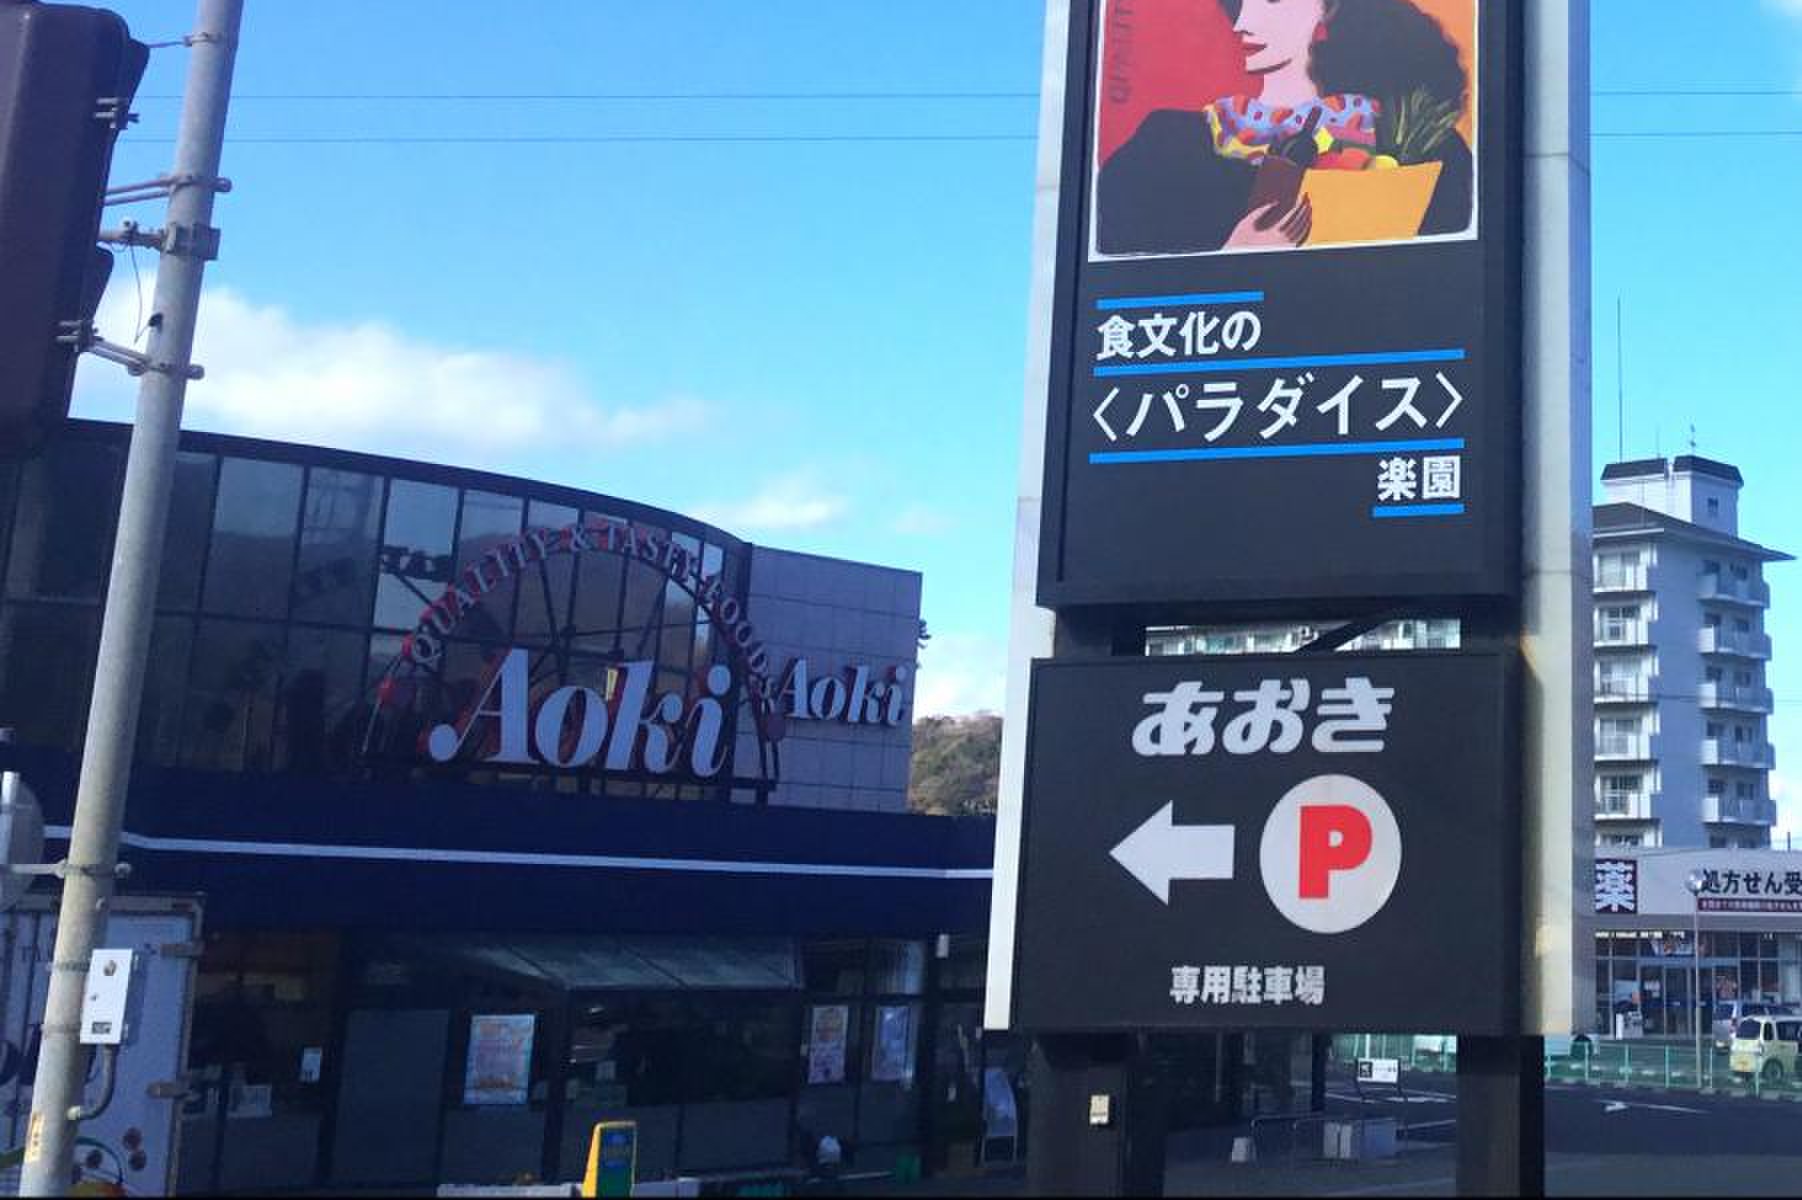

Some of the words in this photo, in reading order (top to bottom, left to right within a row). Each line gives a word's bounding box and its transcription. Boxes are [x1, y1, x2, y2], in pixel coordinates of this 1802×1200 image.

[1096, 311, 1262, 360] 食文化の
[1376, 455, 1461, 502] 楽園
[413, 532, 548, 672] QUALITY
[428, 648, 730, 777] Aoki
[778, 657, 908, 726] Aoki
[1132, 676, 1395, 757] あおき
[1298, 805, 1373, 900] P
[1701, 868, 1802, 896] 処方せん受
[1595, 862, 1634, 913] 薬
[1169, 965, 1325, 1005] 専用駐車場
